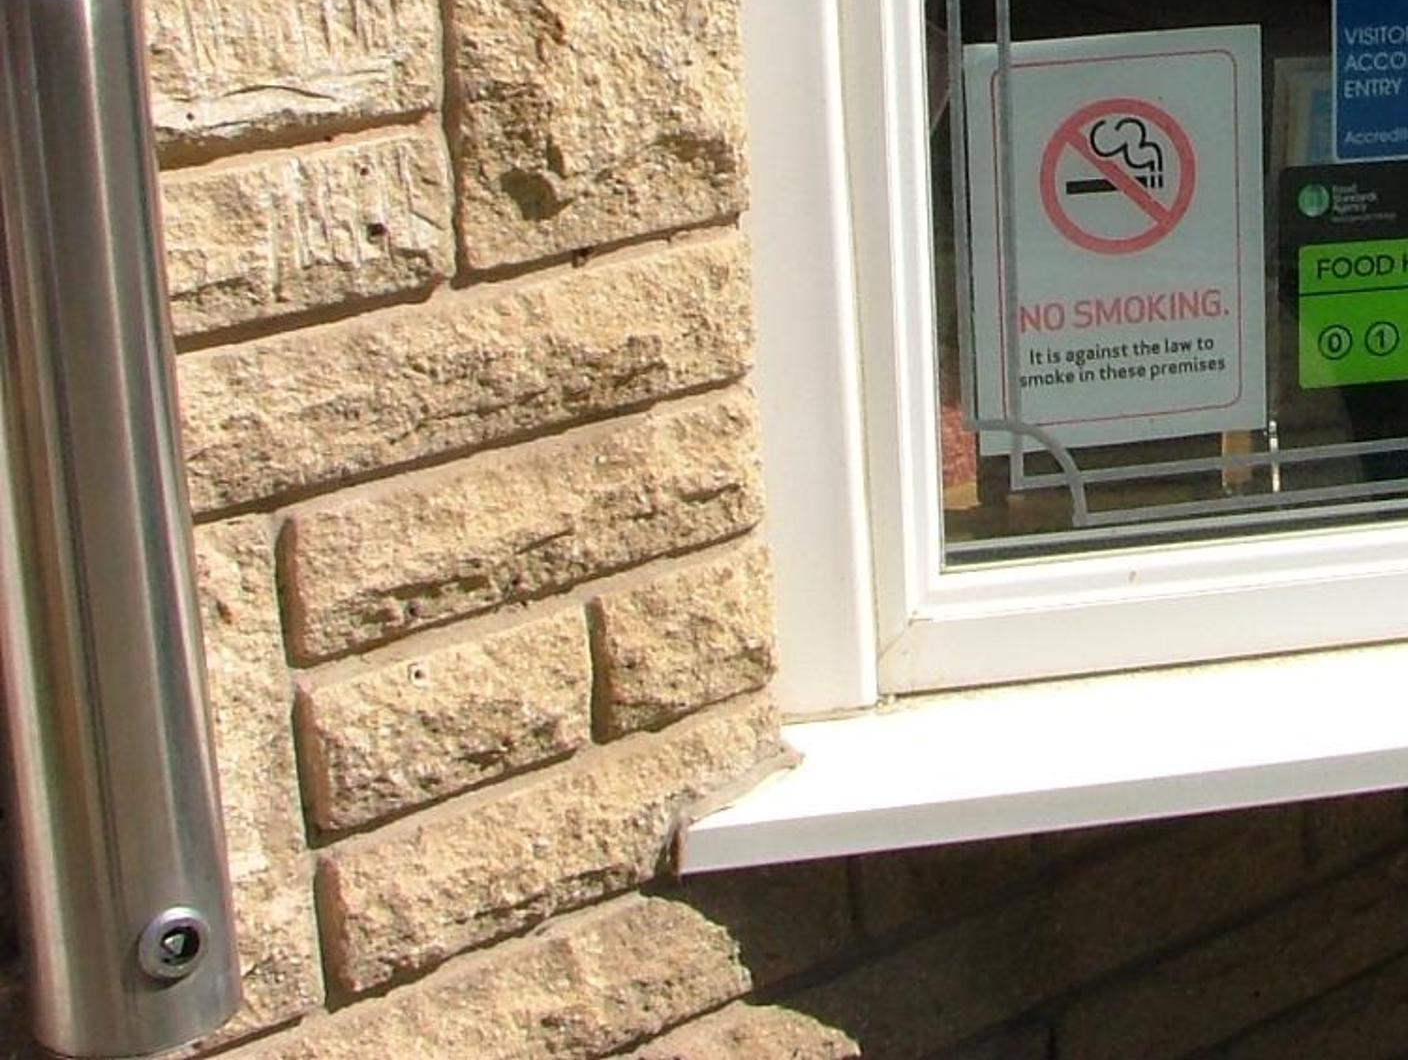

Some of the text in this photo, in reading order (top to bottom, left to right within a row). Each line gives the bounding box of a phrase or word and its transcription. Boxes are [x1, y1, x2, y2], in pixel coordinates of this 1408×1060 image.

[1344, 79, 1403, 99] ENTRY
[1317, 254, 1395, 280] FOOD
[1019, 289, 1230, 333] NO SMOKING.
[1029, 337, 1215, 366] It is against the law to
[1019, 355, 1227, 388] smoke in these premises
